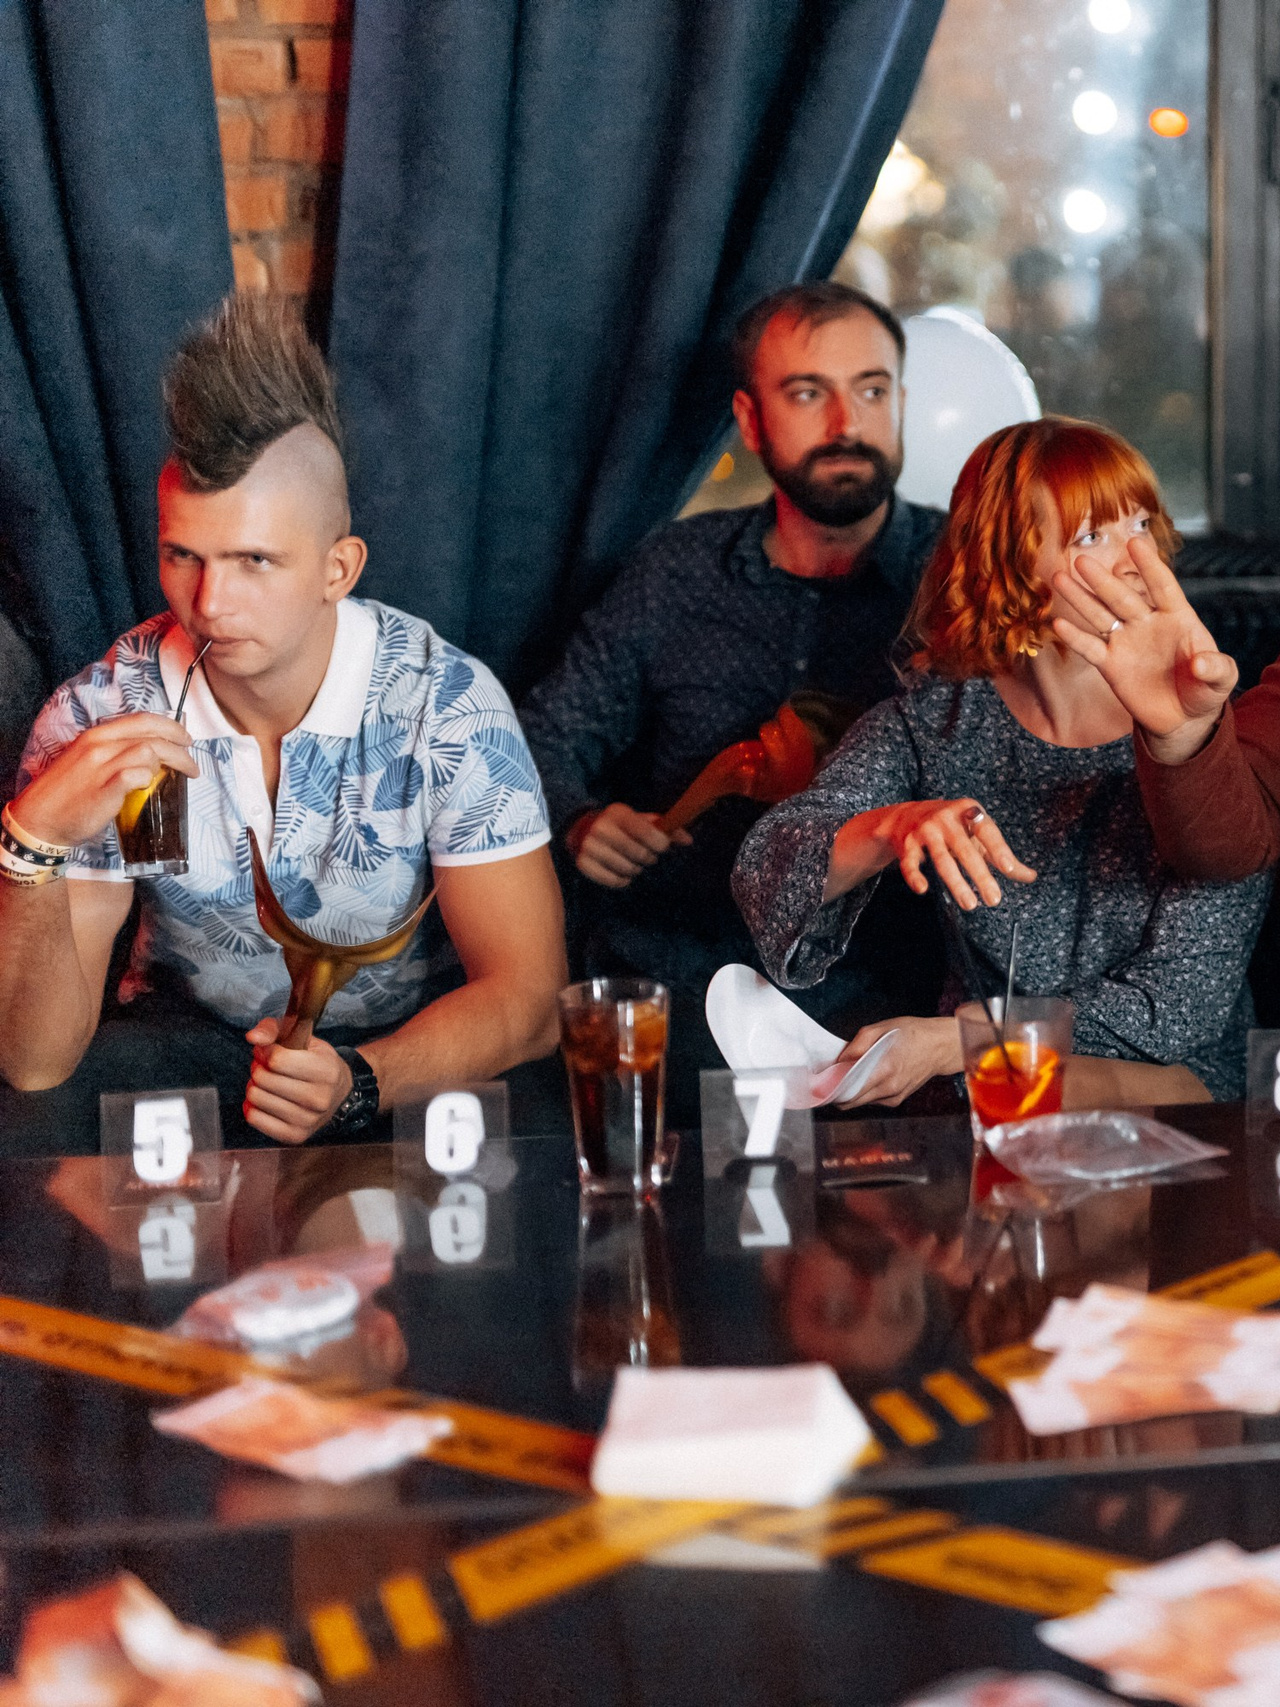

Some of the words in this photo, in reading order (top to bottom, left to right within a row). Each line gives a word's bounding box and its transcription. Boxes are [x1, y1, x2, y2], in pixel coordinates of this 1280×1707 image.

[133, 1097, 192, 1181] 5
[425, 1091, 486, 1174] 6
[733, 1079, 786, 1157] 7
